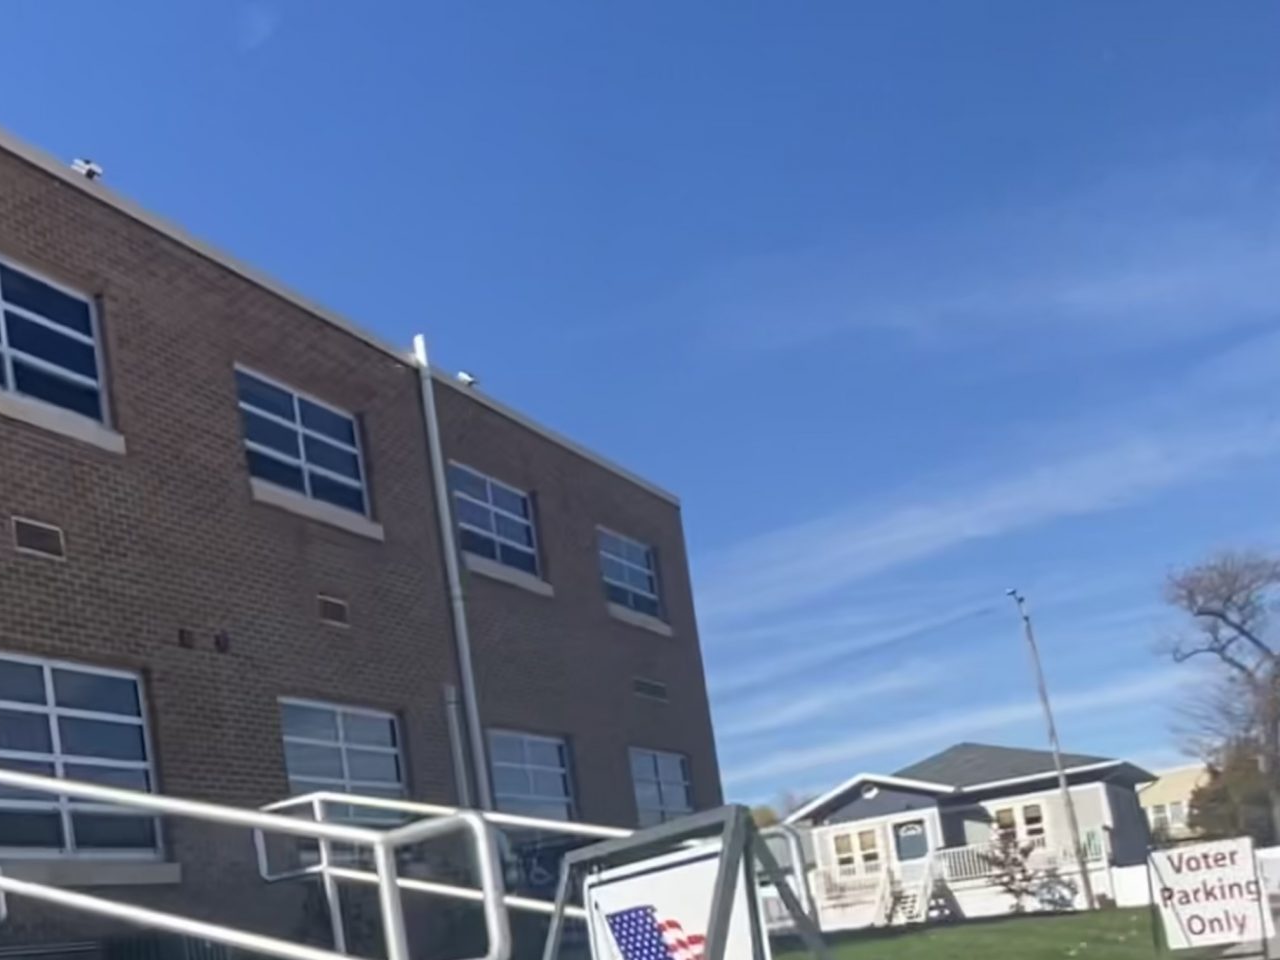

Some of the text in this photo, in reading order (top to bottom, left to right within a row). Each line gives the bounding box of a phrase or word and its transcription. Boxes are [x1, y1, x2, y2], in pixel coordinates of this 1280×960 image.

[1167, 850, 1238, 874] Voter
[1160, 877, 1262, 908] Parking
[1186, 909, 1247, 936] Only
